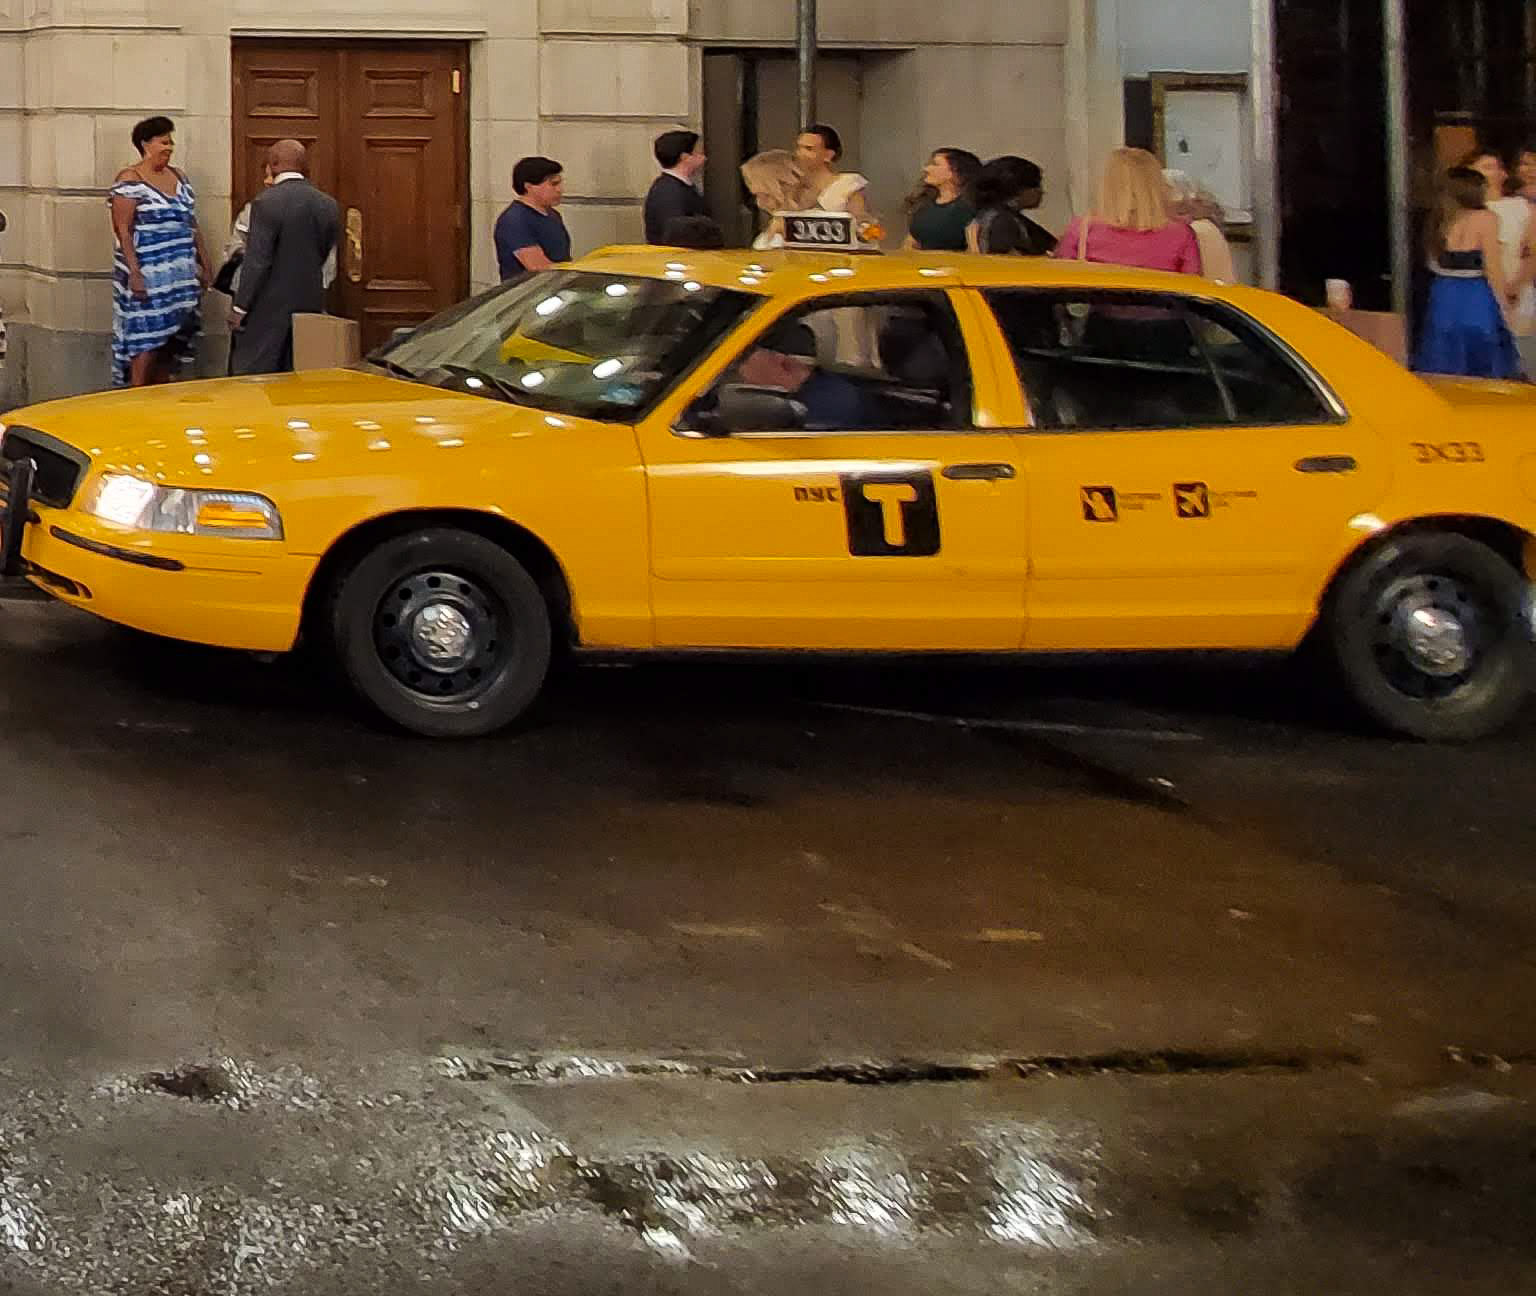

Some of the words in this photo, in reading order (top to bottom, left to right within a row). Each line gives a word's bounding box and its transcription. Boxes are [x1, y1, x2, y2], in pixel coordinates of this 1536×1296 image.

[793, 220, 846, 242] 3X33
[1410, 442, 1485, 464] 3X33
[862, 483, 919, 547] T
